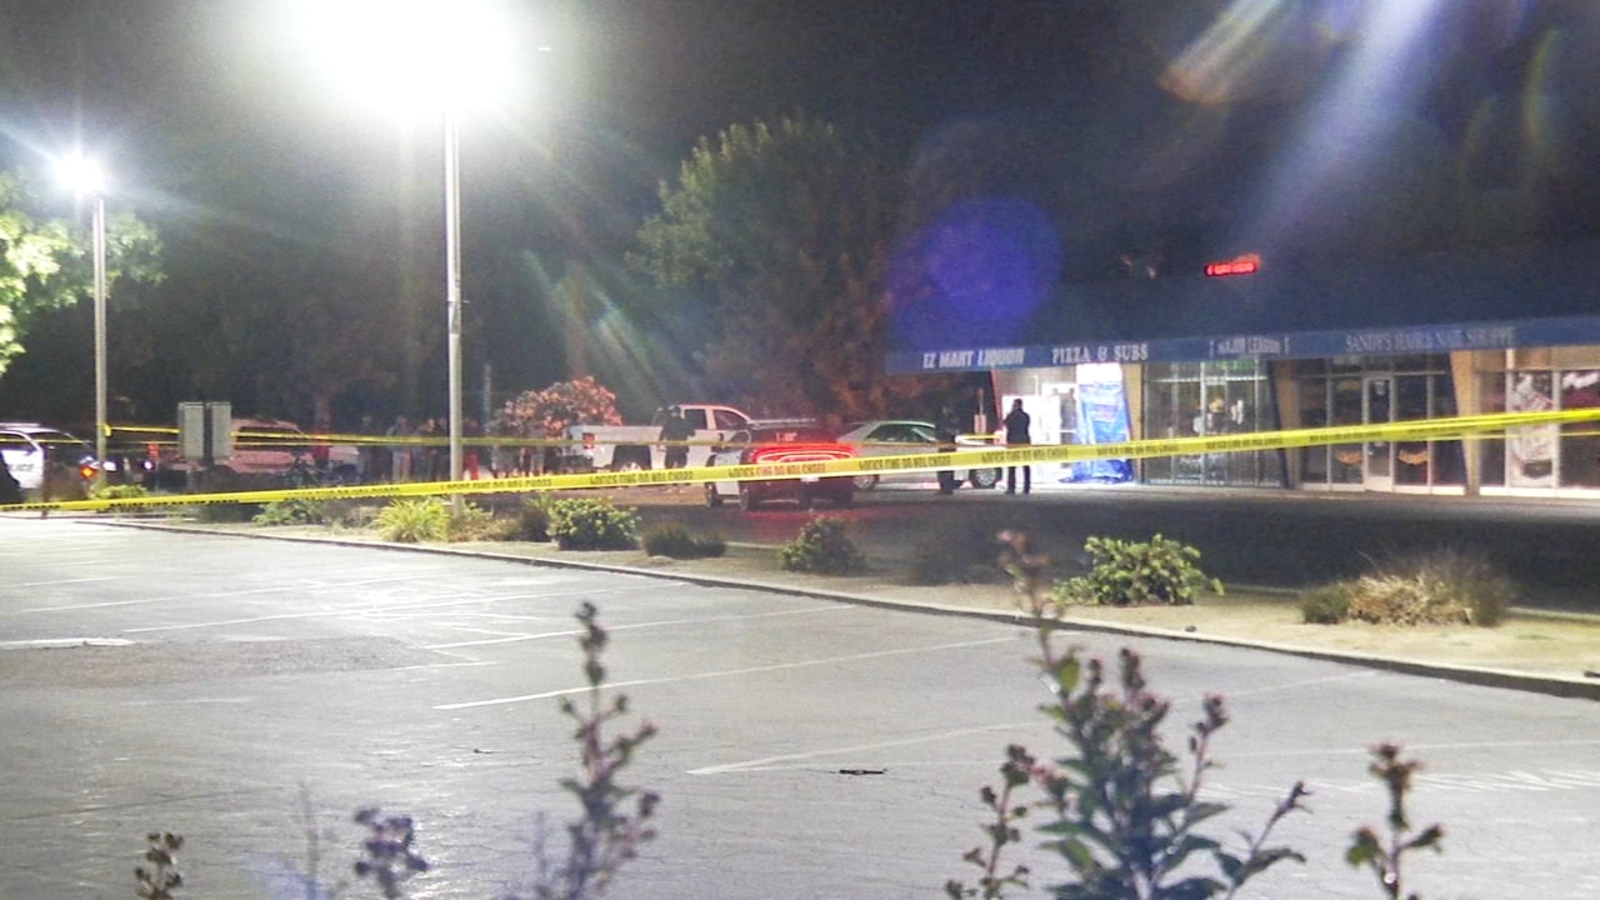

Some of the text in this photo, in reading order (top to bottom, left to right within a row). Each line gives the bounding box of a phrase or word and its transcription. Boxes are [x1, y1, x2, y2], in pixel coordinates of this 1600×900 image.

[922, 347, 1025, 369] EZ MART LIQUOR
[1051, 343, 1148, 364] PIZZA & SUBS
